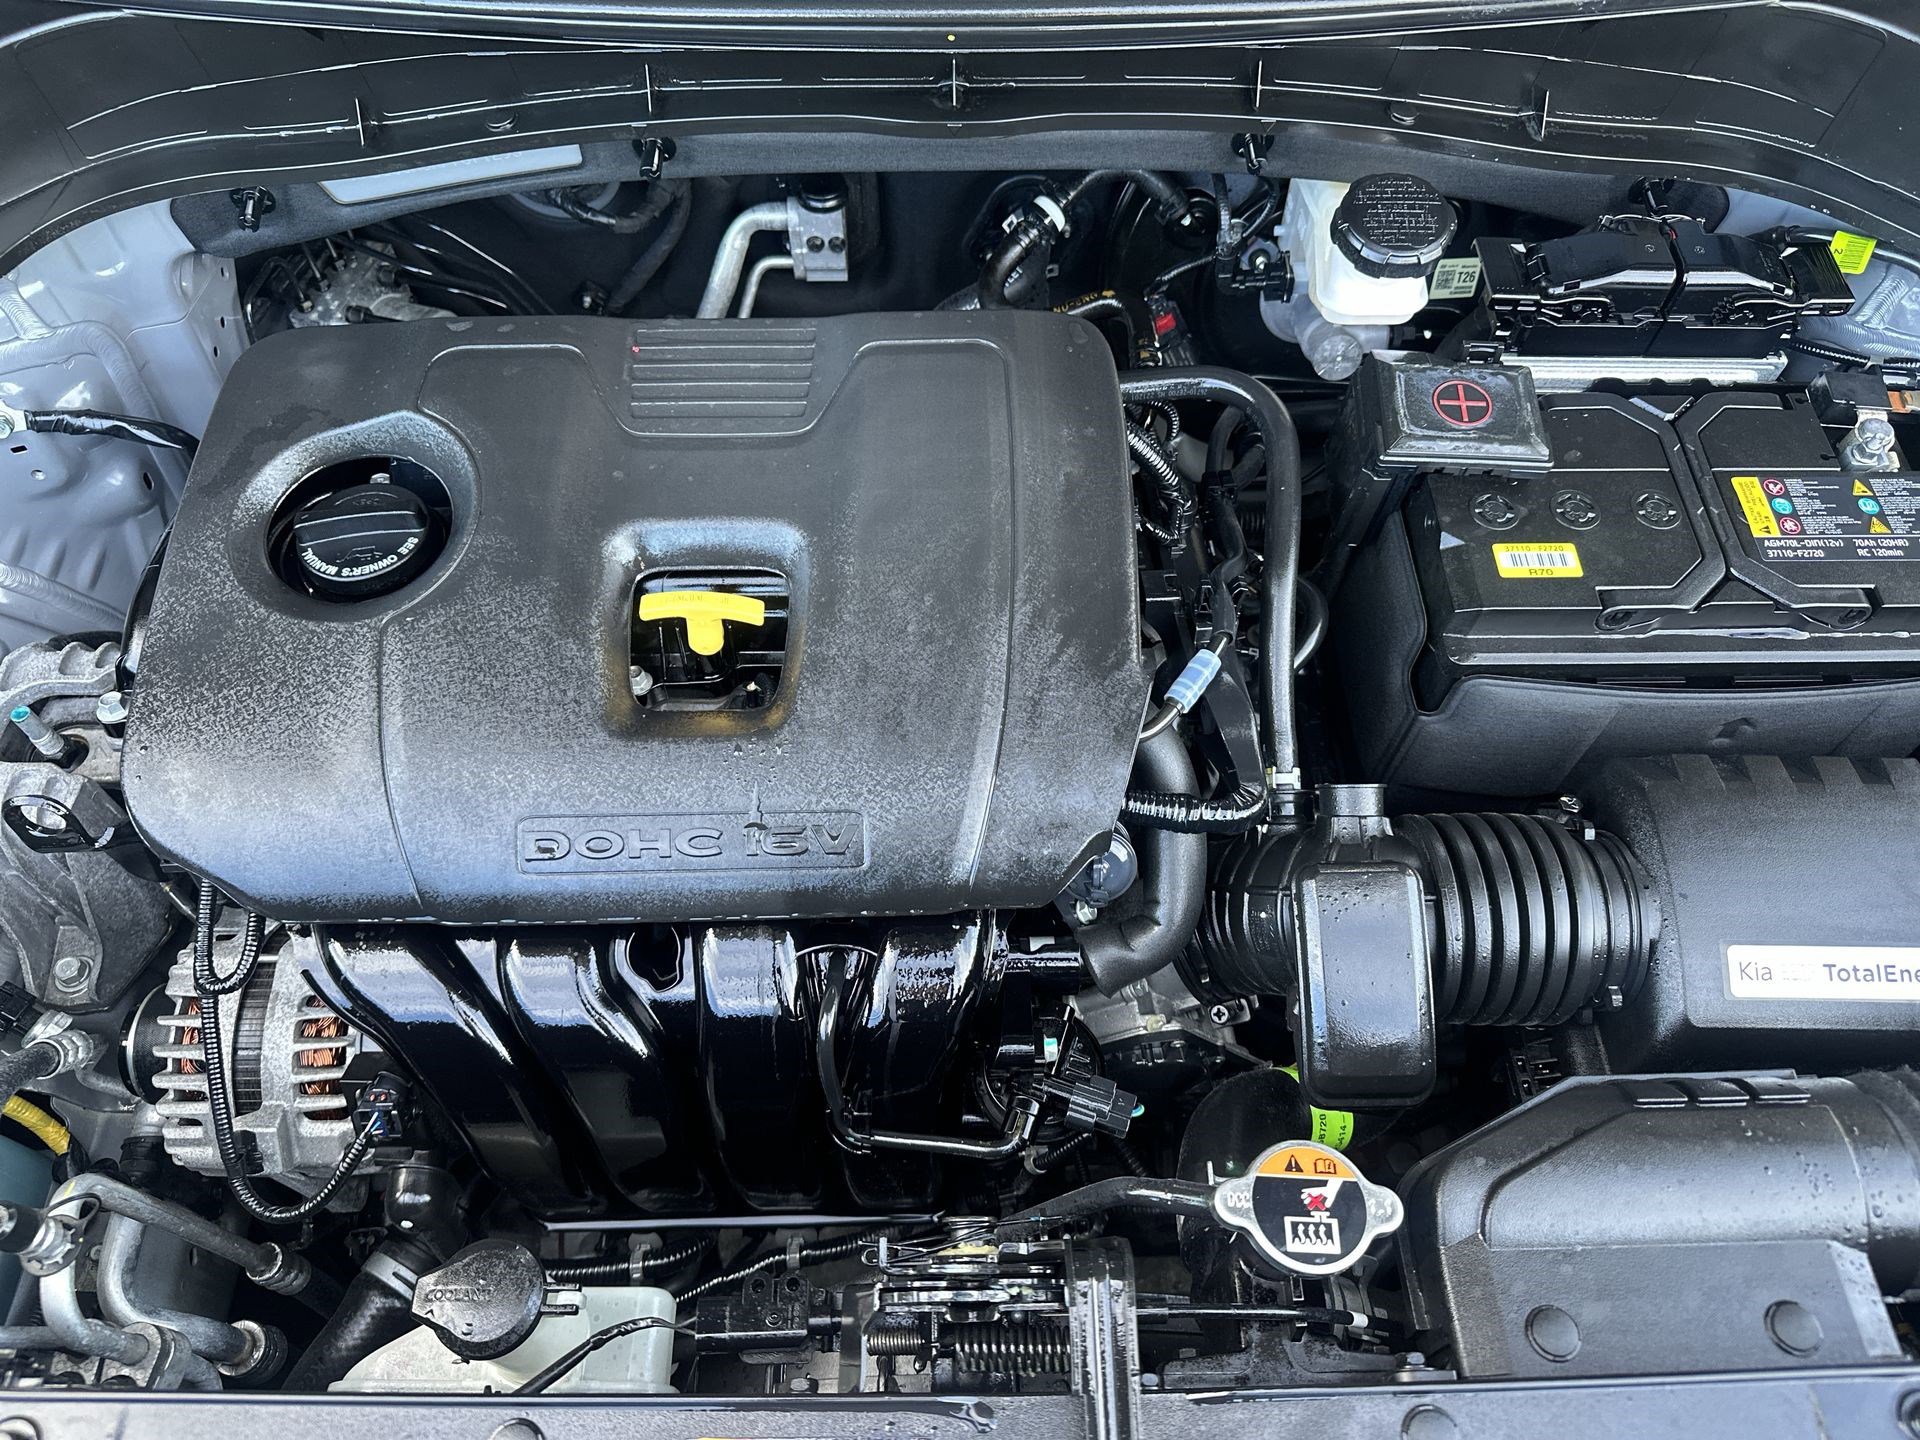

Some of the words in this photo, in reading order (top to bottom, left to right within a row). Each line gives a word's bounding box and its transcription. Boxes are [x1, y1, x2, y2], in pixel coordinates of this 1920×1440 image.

[1457, 271, 1477, 284] T26
[397, 536, 419, 555] SEE
[1852, 539, 1877, 547] 70Ah
[1878, 539, 1909, 547] (20HR)
[301, 547, 339, 576] MANUAL
[1766, 549, 1825, 558] 37110-F2720
[1857, 548, 1871, 557] RC
[1872, 548, 1904, 557] 120min
[341, 554, 398, 577] OWNER'S
[1528, 568, 1554, 576] R70
[524, 828, 723, 863] DOHC
[743, 823, 859, 857] 16V
[1739, 961, 1773, 981] Kia
[425, 1286, 495, 1302] COOLANT
